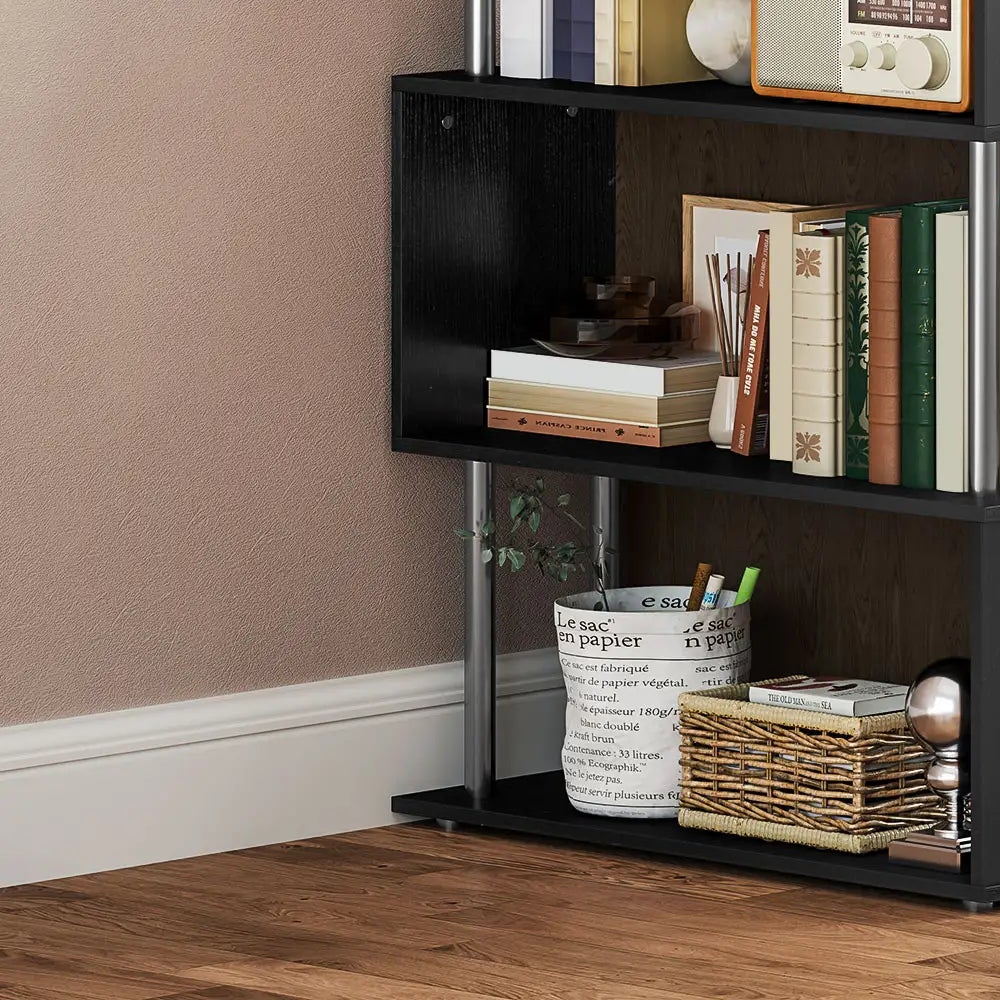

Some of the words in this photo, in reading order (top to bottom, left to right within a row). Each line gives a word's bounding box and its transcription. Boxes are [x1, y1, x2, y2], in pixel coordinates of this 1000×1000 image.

[557, 611, 576, 629] Le
[559, 632, 575, 643] en
[579, 634, 642, 651] papier
[706, 628, 745, 651] papier
[572, 662, 583, 670] sac
[600, 663, 649, 675] fabriqué
[695, 664, 716, 673] sac
[587, 677, 599, 686] de
[601, 679, 639, 689] papier
[642, 678, 688, 689] végétal.
[583, 693, 619, 703] naturel.
[768, 693, 780, 702] THE
[780, 695, 792, 704] OLD
[792, 697, 806, 706] MAN
[821, 700, 832, 710] SEA
[589, 705, 635, 716] épaisseur
[603, 721, 640, 731] doublé
[591, 733, 615, 744] brun
[564, 755, 576, 765] 100
[619, 749, 630, 759] 33
[632, 750, 663, 760] litres.
[578, 769, 585, 778] le
[585, 771, 604, 782] jetez
[605, 776, 622, 785] pas.
[588, 788, 612, 798] servir
[614, 790, 665, 801] plusieurs
